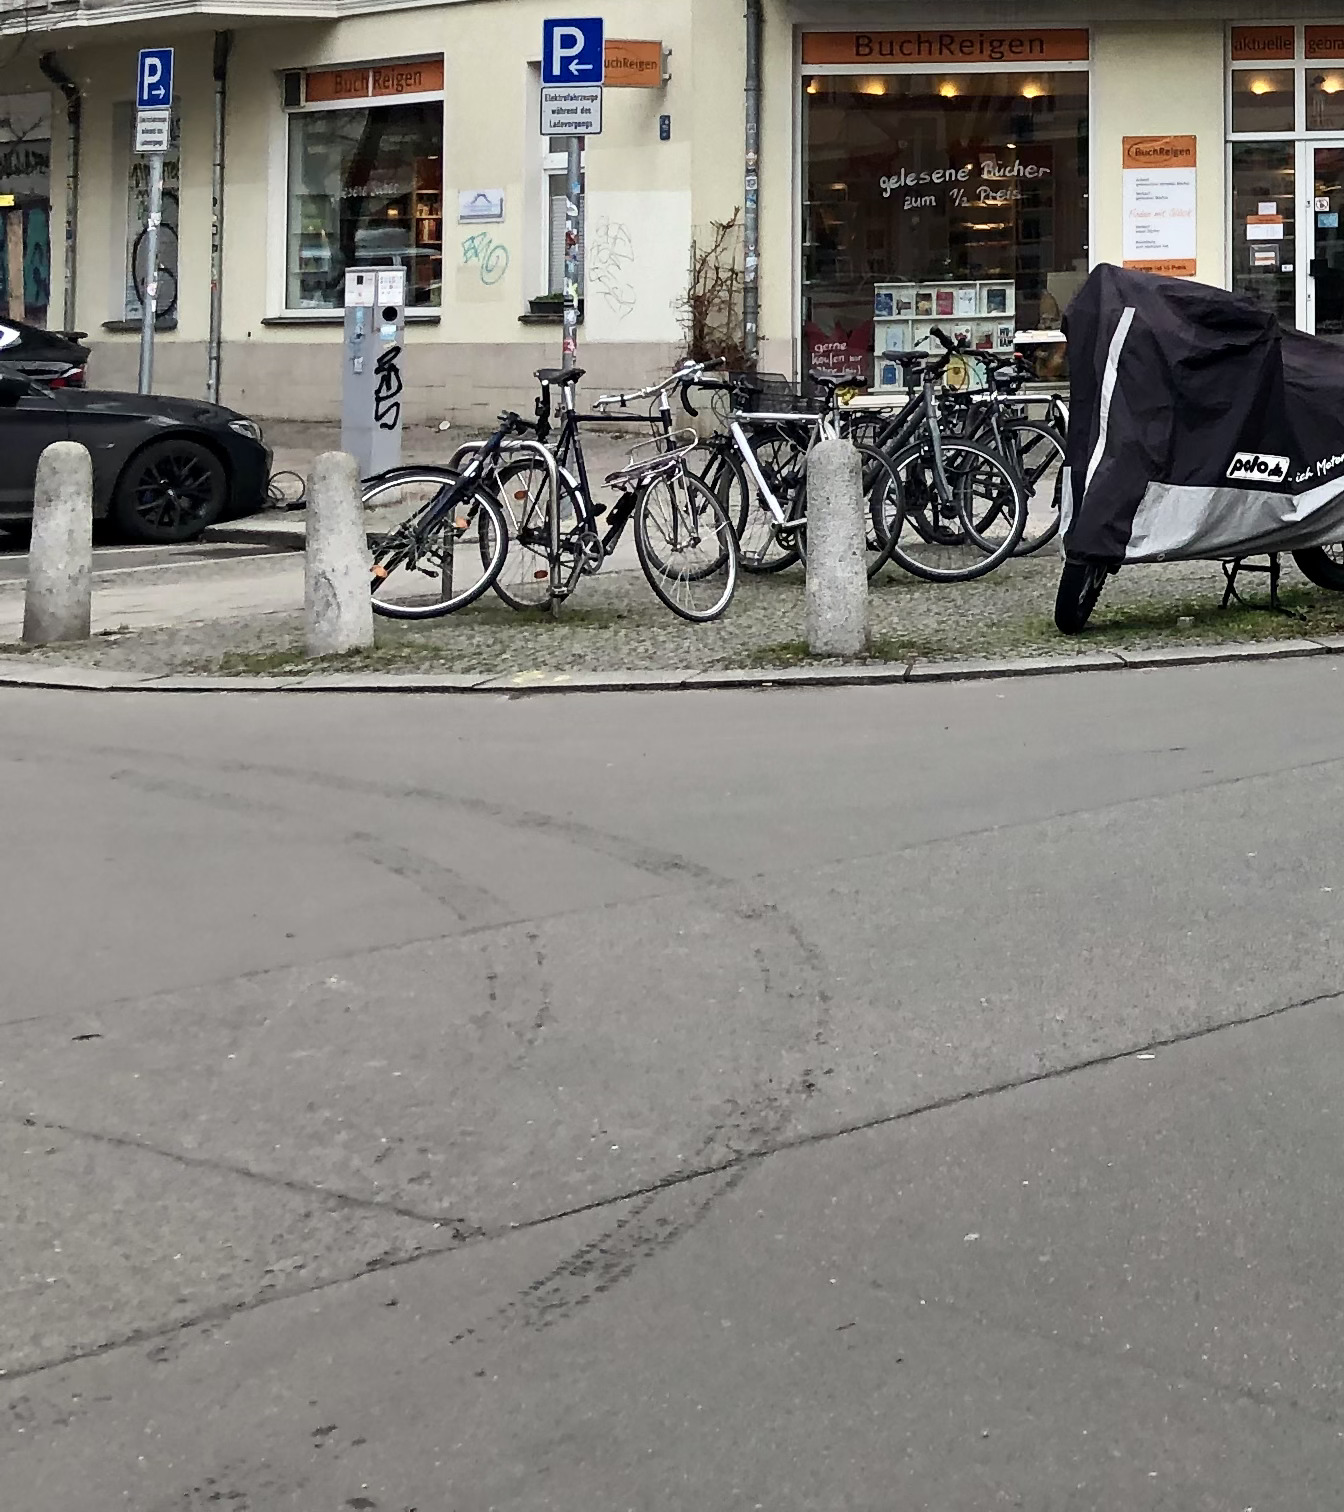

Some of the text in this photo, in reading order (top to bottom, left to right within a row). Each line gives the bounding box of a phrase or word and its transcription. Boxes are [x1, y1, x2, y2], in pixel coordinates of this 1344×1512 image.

[855, 33, 1045, 60] BuchReigen
[1233, 36, 1292, 52] aktuelle
[603, 57, 657, 71] uchReigen
[1134, 147, 1191, 157] BuchReigen
[879, 159, 1051, 198] gelesene Bücher
[903, 194, 936, 210] zum
[976, 185, 1022, 202] Preis
[814, 342, 848, 354] gerne
[1230, 455, 1269, 477] polo
[1295, 467, 1314, 483] ich
